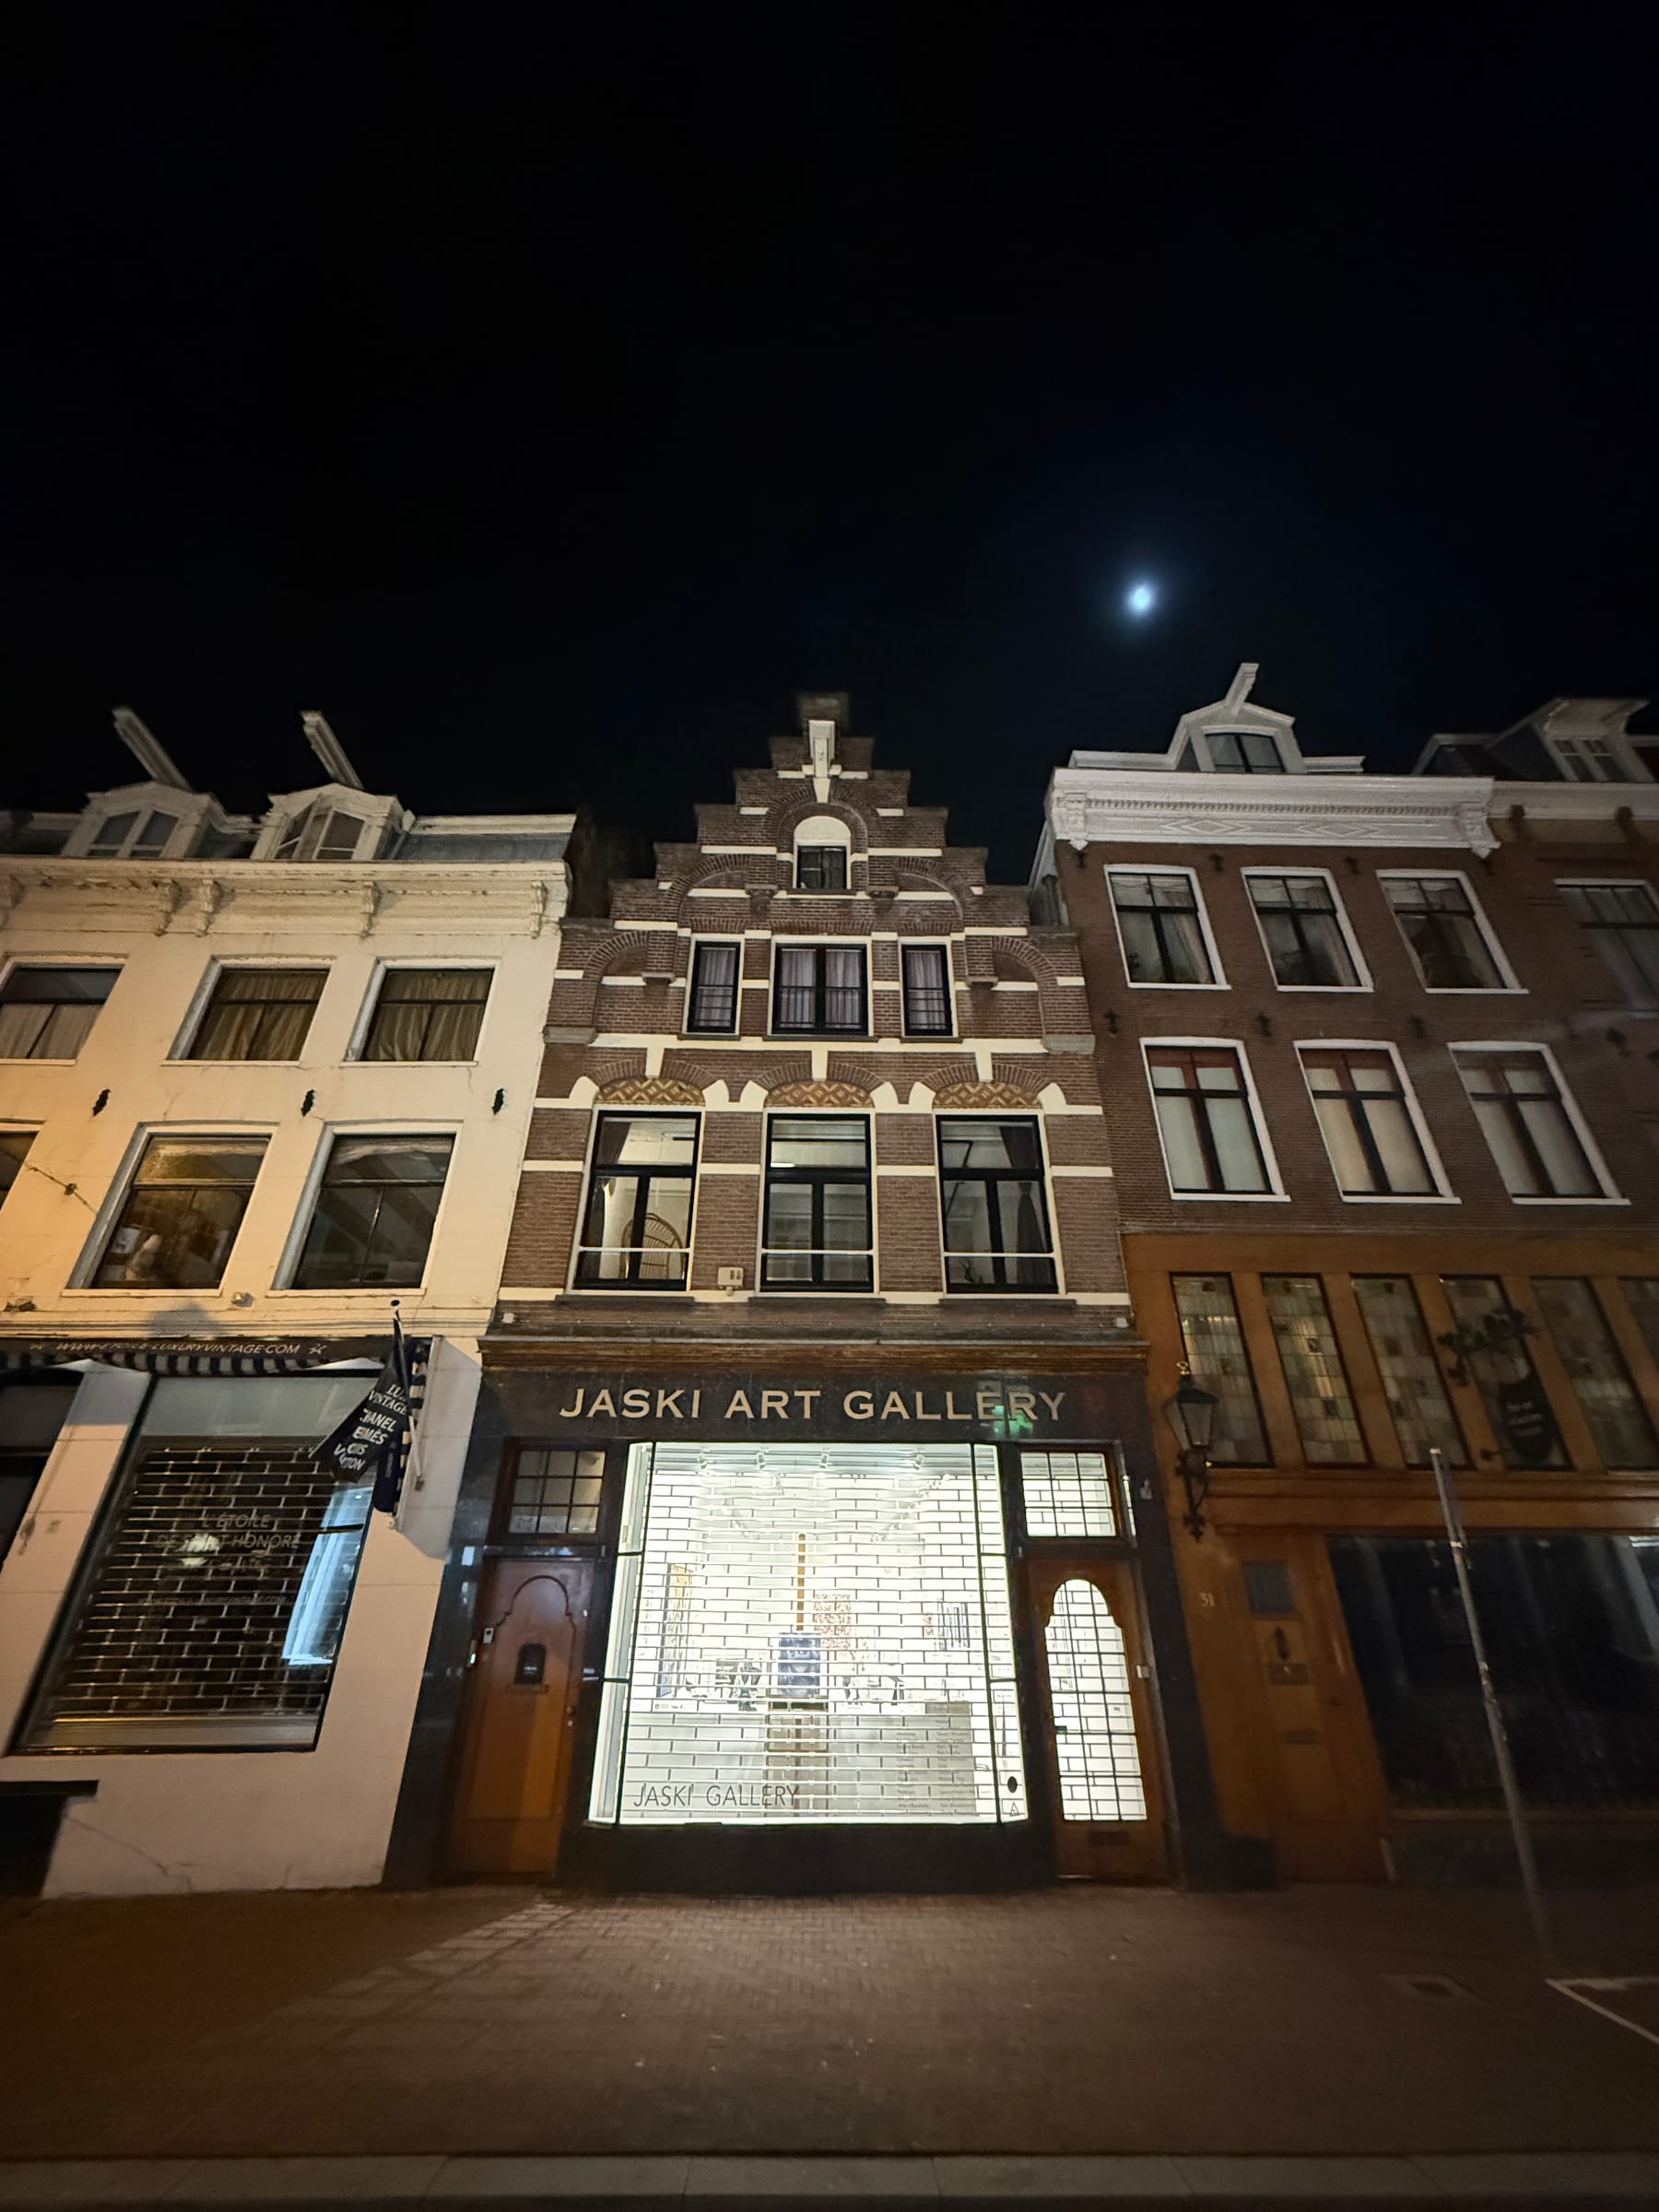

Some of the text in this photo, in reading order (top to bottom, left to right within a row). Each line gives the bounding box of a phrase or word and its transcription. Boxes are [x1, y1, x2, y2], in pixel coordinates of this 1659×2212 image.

[559, 1388, 1065, 1421] JASKI ART GALLERY
[1199, 1592, 1216, 1607] 31
[633, 1783, 799, 1807] JASKI GALLERY
